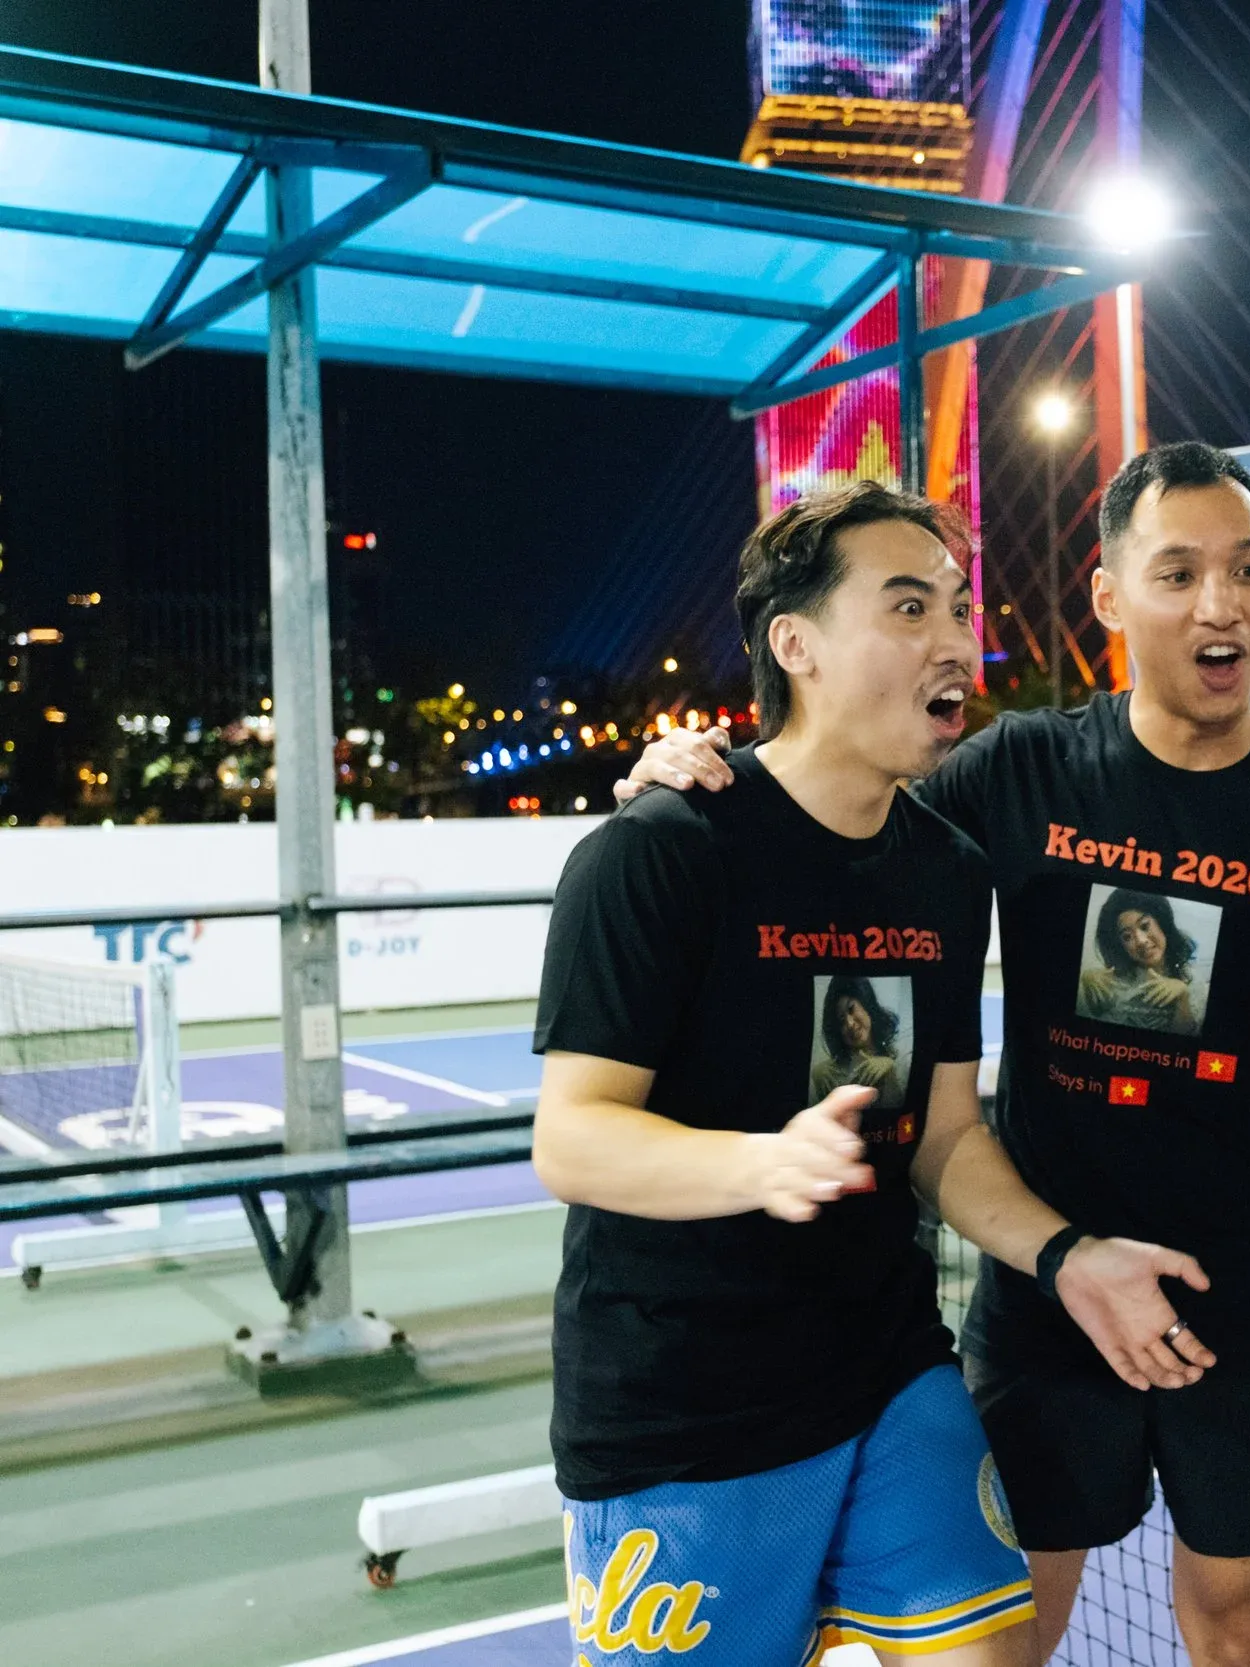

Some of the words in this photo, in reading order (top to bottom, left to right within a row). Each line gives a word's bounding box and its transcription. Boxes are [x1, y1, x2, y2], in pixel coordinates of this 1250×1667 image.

[1046, 823, 1161, 877] Kevin
[348, 936, 420, 957] D-JOY
[757, 923, 857, 959] Kevin
[1049, 1026, 1090, 1050] What
[1093, 1038, 1171, 1067] happens
[1175, 1052, 1190, 1069] in
[1088, 1076, 1102, 1093] in
